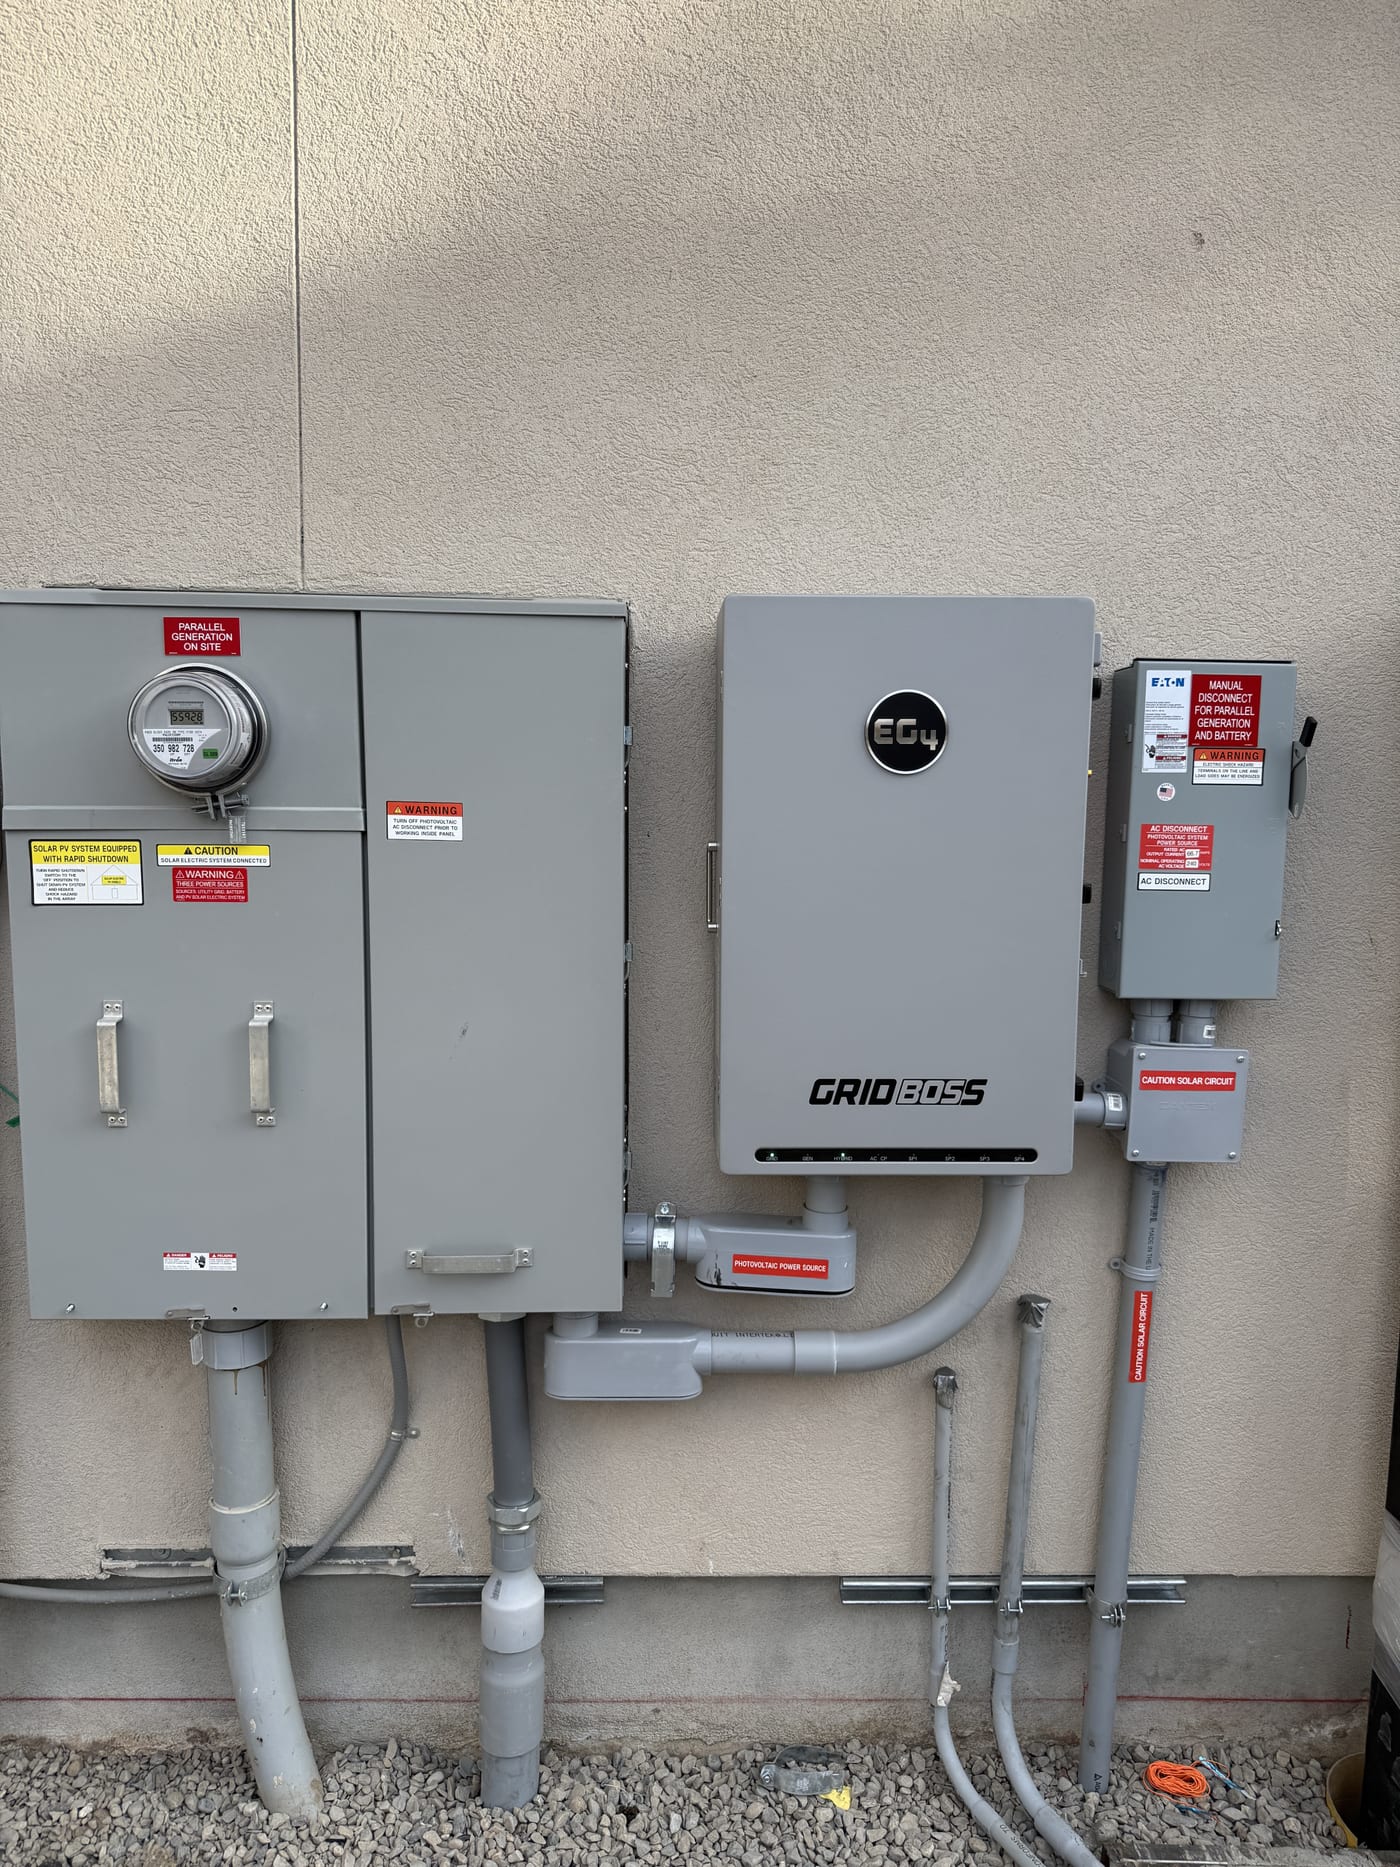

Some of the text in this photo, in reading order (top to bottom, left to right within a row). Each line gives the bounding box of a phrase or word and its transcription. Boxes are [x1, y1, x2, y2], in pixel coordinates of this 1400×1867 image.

[178, 622, 226, 632] PARALLEL
[172, 632, 232, 641] GENERATION
[184, 642, 222, 651] ON SITE
[1209, 680, 1244, 690] MANUAL
[1198, 692, 1253, 703] DISCONNECT
[1194, 705, 1255, 716] FOR PARALLEL
[172, 711, 203, 722] 55928
[1197, 718, 1250, 728] GENERATION
[874, 718, 939, 751] EG4
[1194, 730, 1252, 741] AND BATTERY
[153, 744, 164, 753] 350
[168, 744, 180, 753] 982
[1210, 751, 1259, 760] WARNING
[405, 806, 457, 815] WARNING
[102, 845, 137, 853] EQUIPPED
[194, 846, 238, 855] CAUTION
[42, 855, 129, 863] WITH RAPID SHUTDOWN
[185, 870, 234, 879] WARNING
[1142, 1076, 1234, 1086] CAUTION SOLAR CIRCUIT
[734, 1260, 826, 1272] PHOTOVOLTAIC POWER SOURCE
[1135, 1292, 1148, 1381] CAUTION SOLAR CIRCUIT
